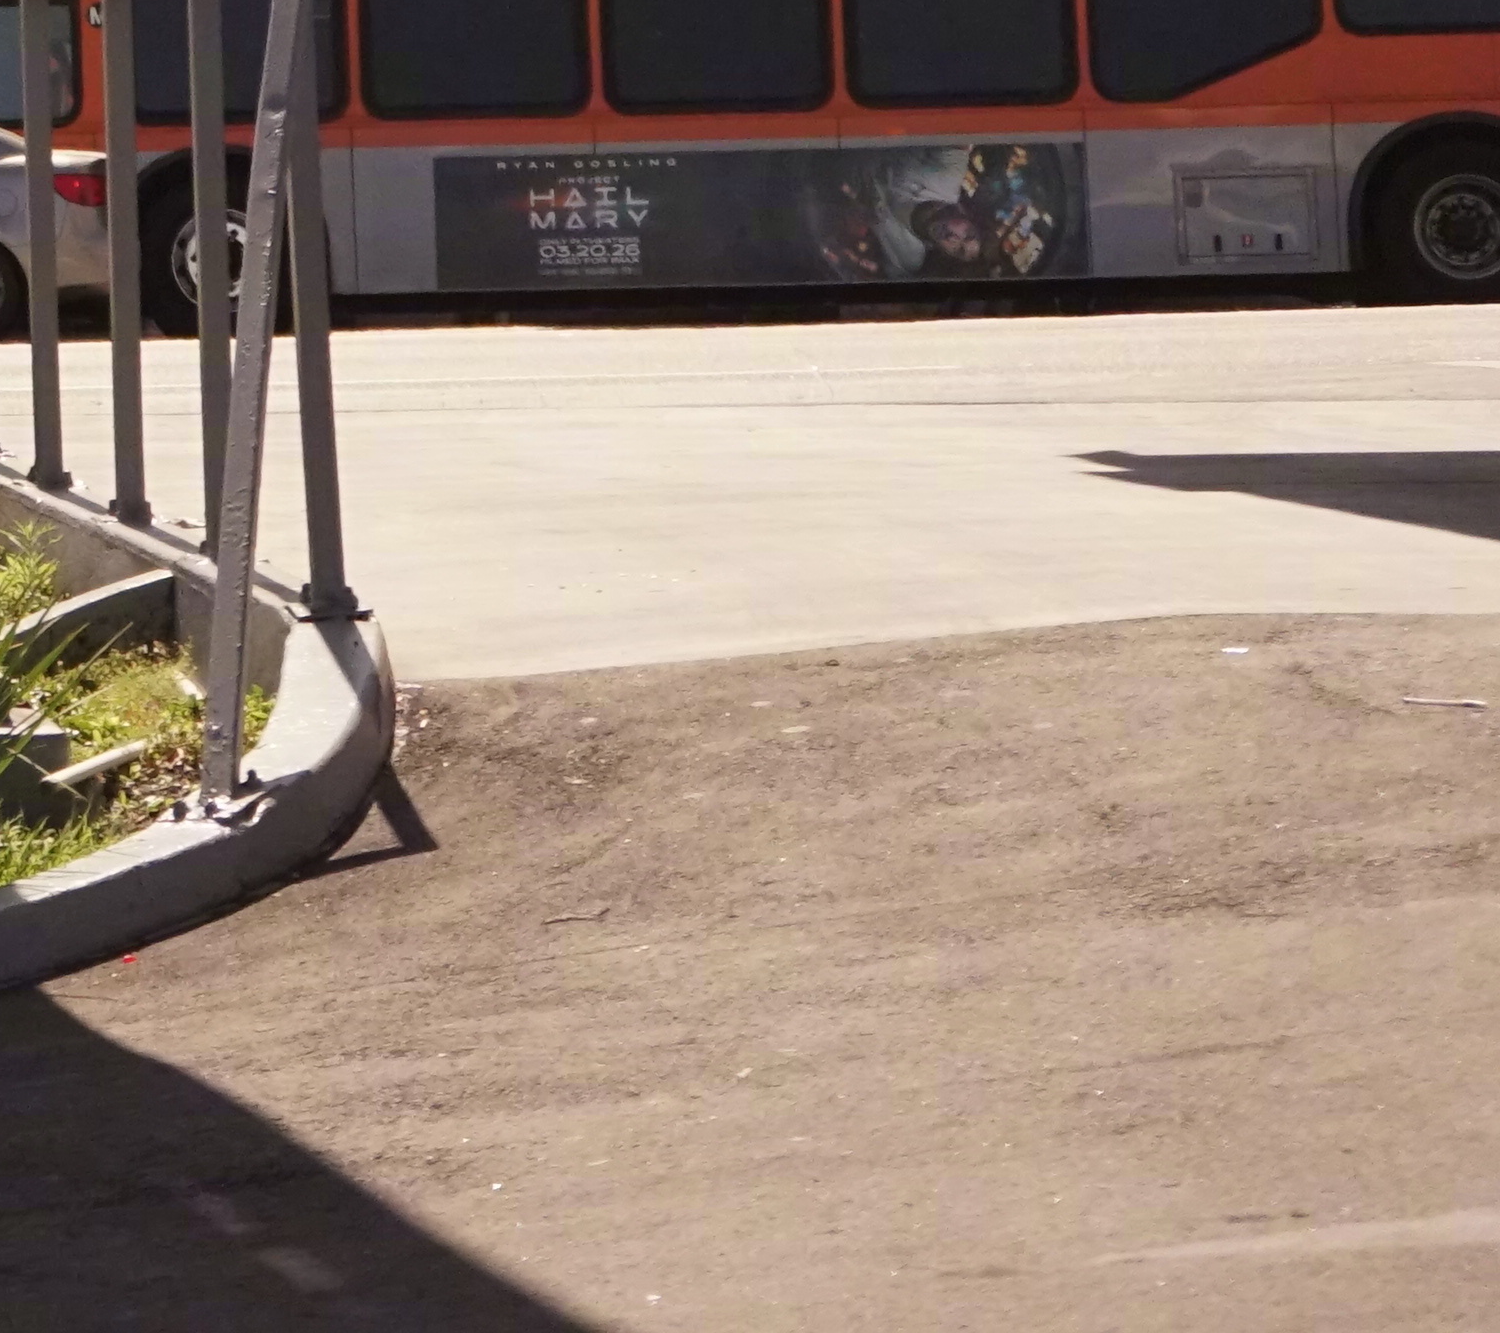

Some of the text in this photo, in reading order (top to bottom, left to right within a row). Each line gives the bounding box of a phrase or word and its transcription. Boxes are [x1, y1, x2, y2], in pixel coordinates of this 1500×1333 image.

[496, 158, 678, 170] RYAN GOSLING
[529, 186, 650, 208] HAIL
[529, 208, 649, 230] MARY
[539, 243, 641, 258] 03.20.26
